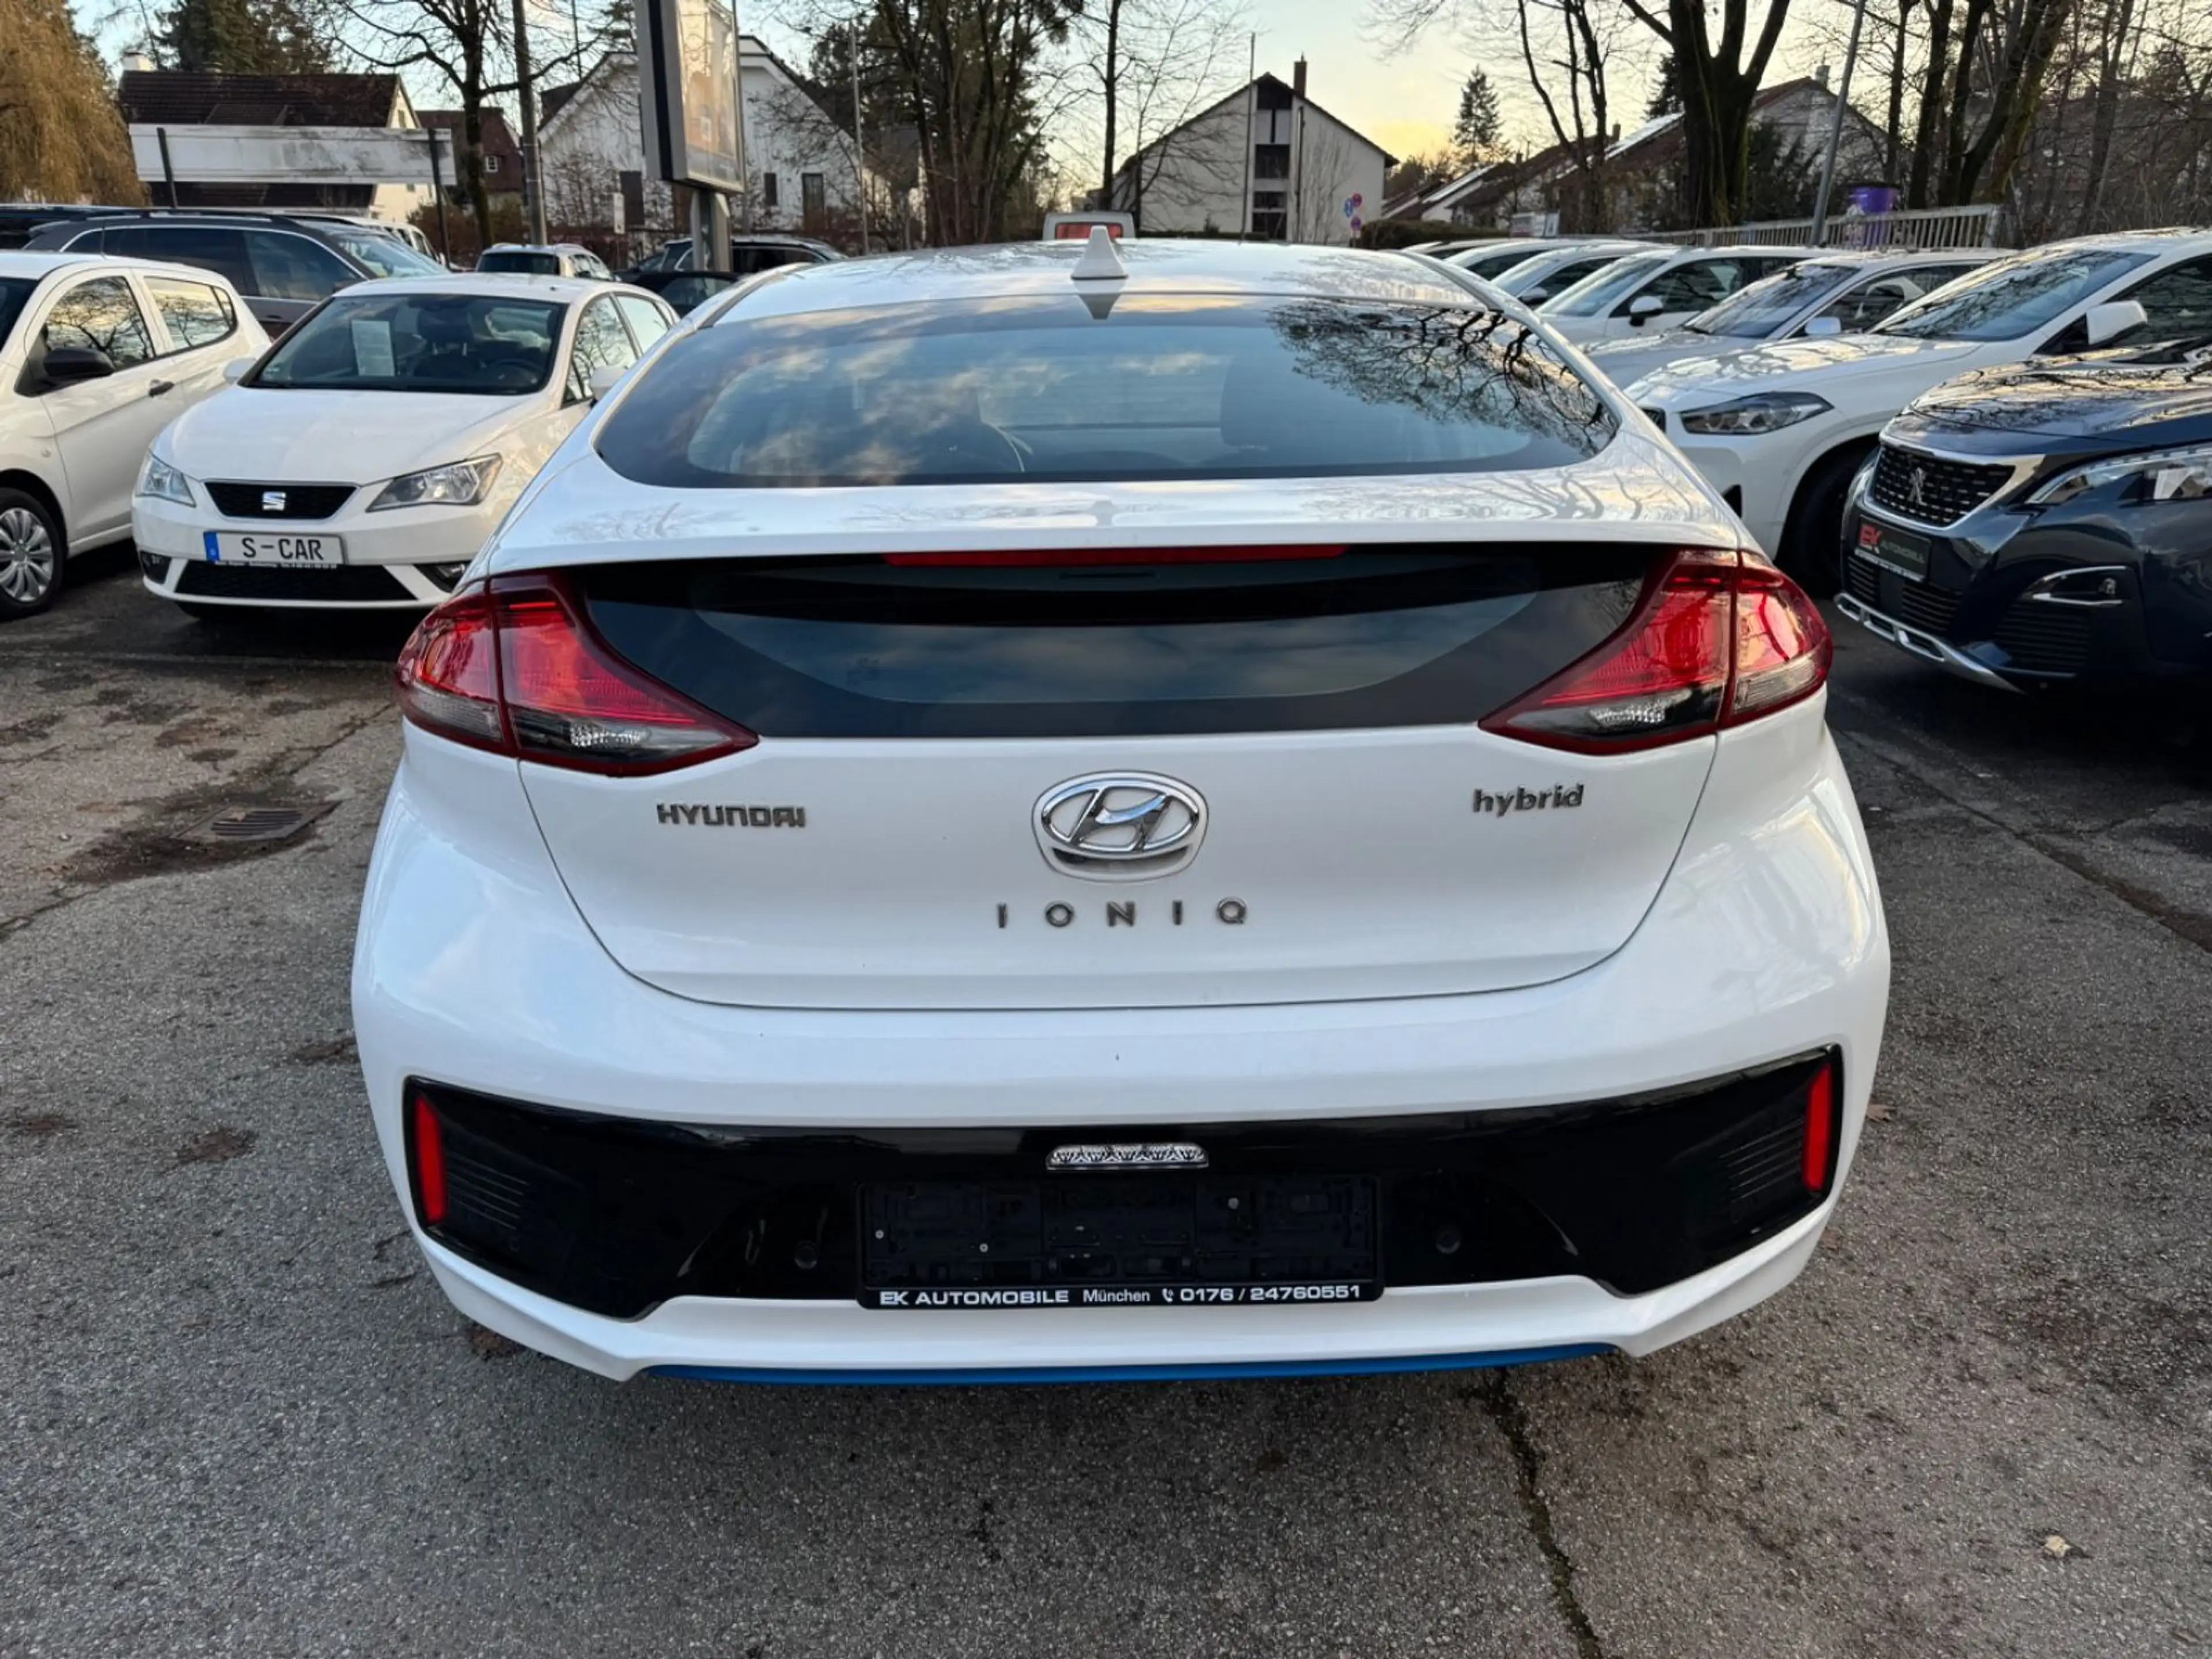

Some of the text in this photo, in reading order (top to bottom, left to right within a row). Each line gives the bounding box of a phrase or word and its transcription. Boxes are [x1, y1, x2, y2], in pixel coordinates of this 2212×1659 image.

[1472, 783, 1585, 818] hybrid
[656, 804, 805, 828] HYUNDAI
[997, 897, 1248, 929] IONIQ
[880, 1291, 908, 1305] EK
[915, 1290, 1069, 1305] AUTOMOBILE
[1083, 1289, 1150, 1302] München
[1180, 1288, 1234, 1302] 0176
[1250, 1285, 1360, 1301] 24760551
